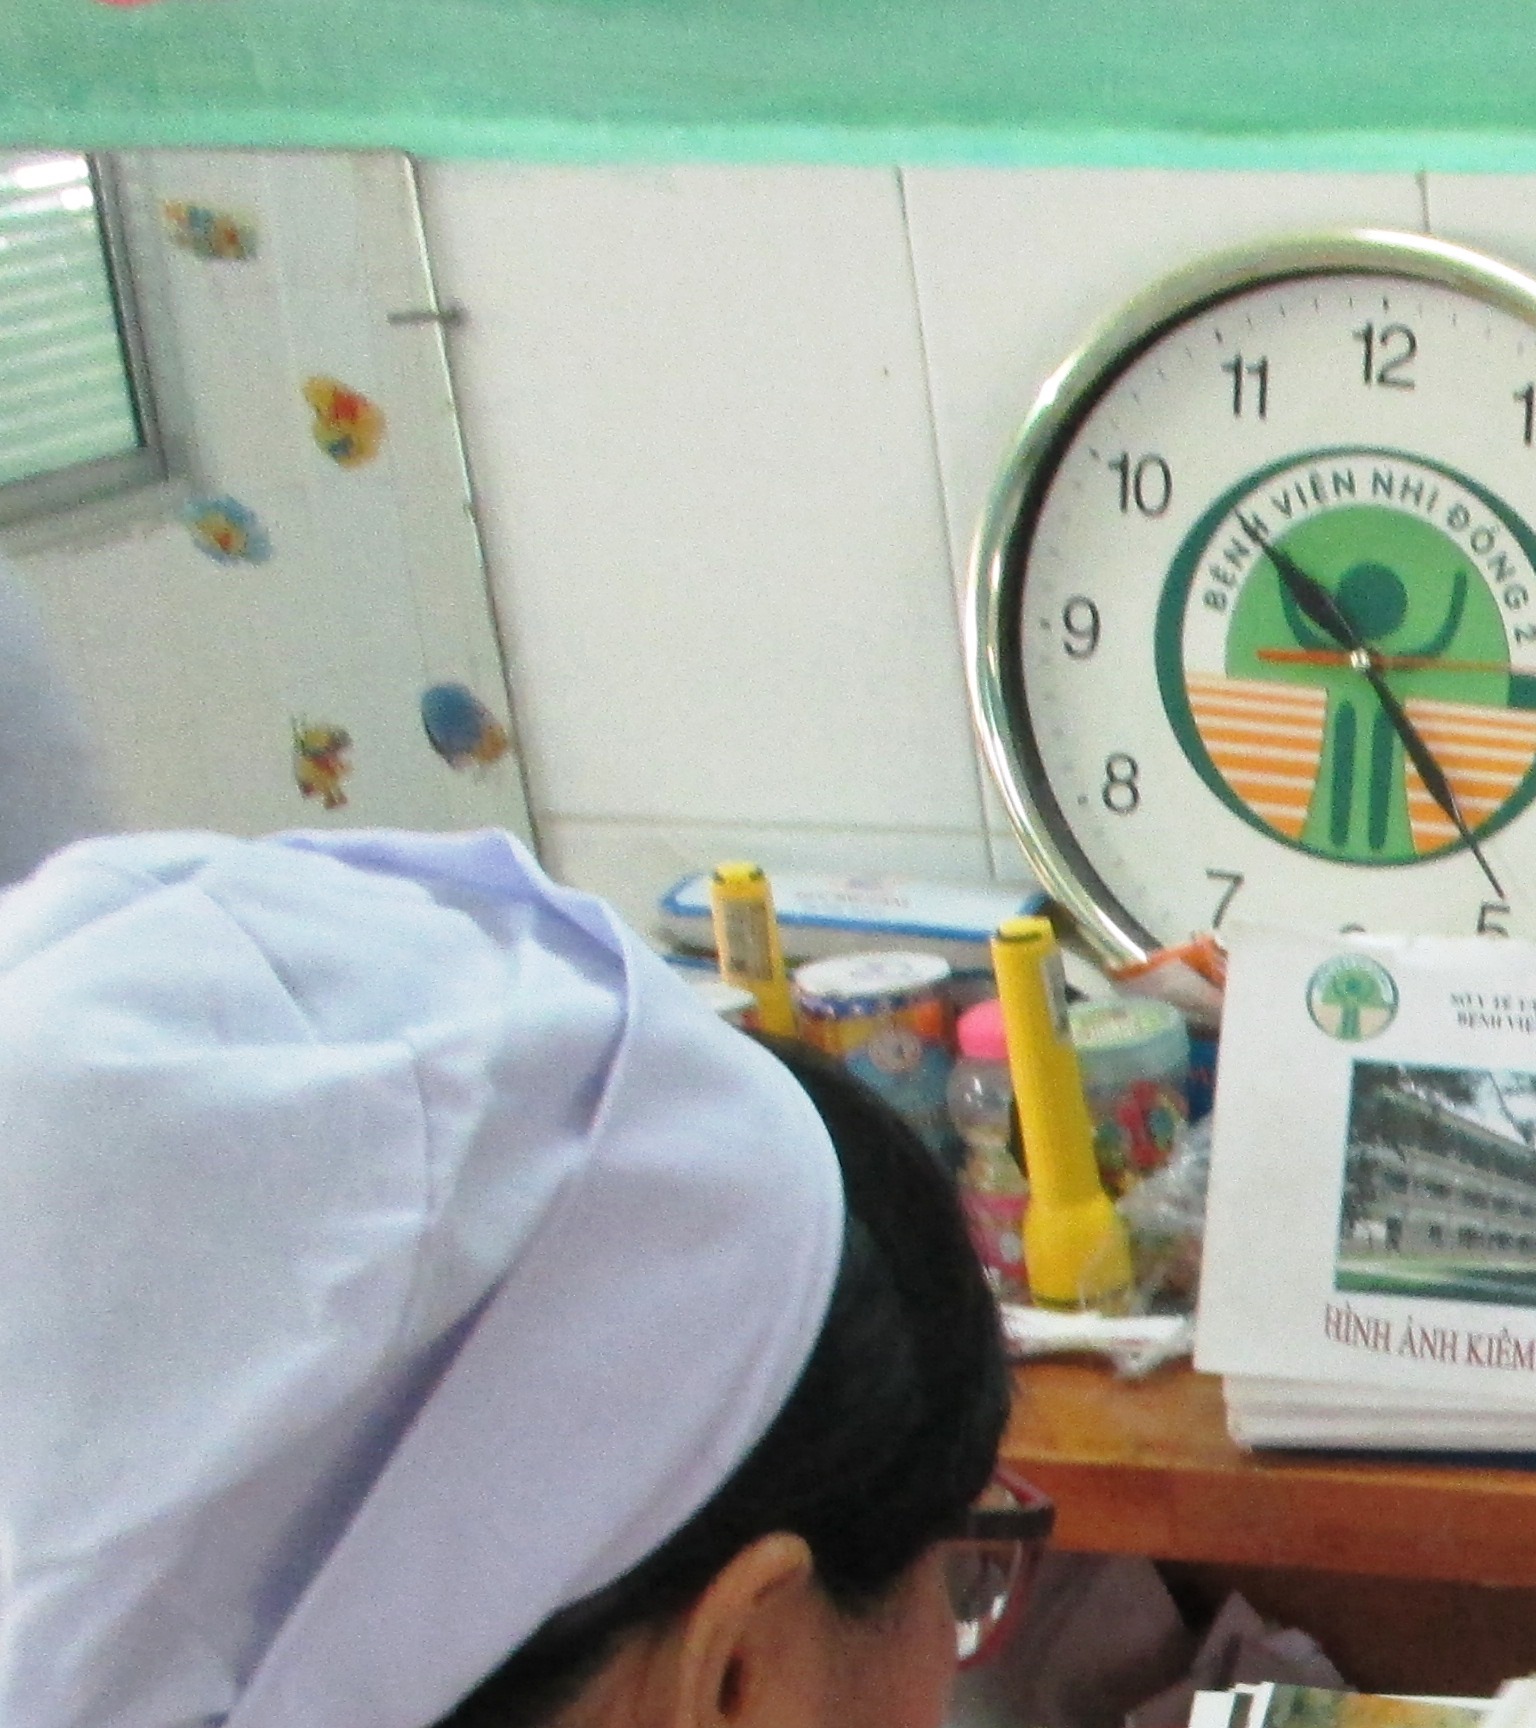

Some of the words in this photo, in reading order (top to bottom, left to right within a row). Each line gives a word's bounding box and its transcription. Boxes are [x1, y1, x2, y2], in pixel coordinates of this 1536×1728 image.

[1223, 353, 1270, 419] 11
[1353, 321, 1418, 389] 12
[1512, 382, 1536, 446] 1
[1109, 452, 1172, 517] 10
[1370, 465, 1441, 516] NHI
[1062, 596, 1101, 660] 9
[1101, 754, 1141, 816] 8
[1205, 868, 1245, 930] 7
